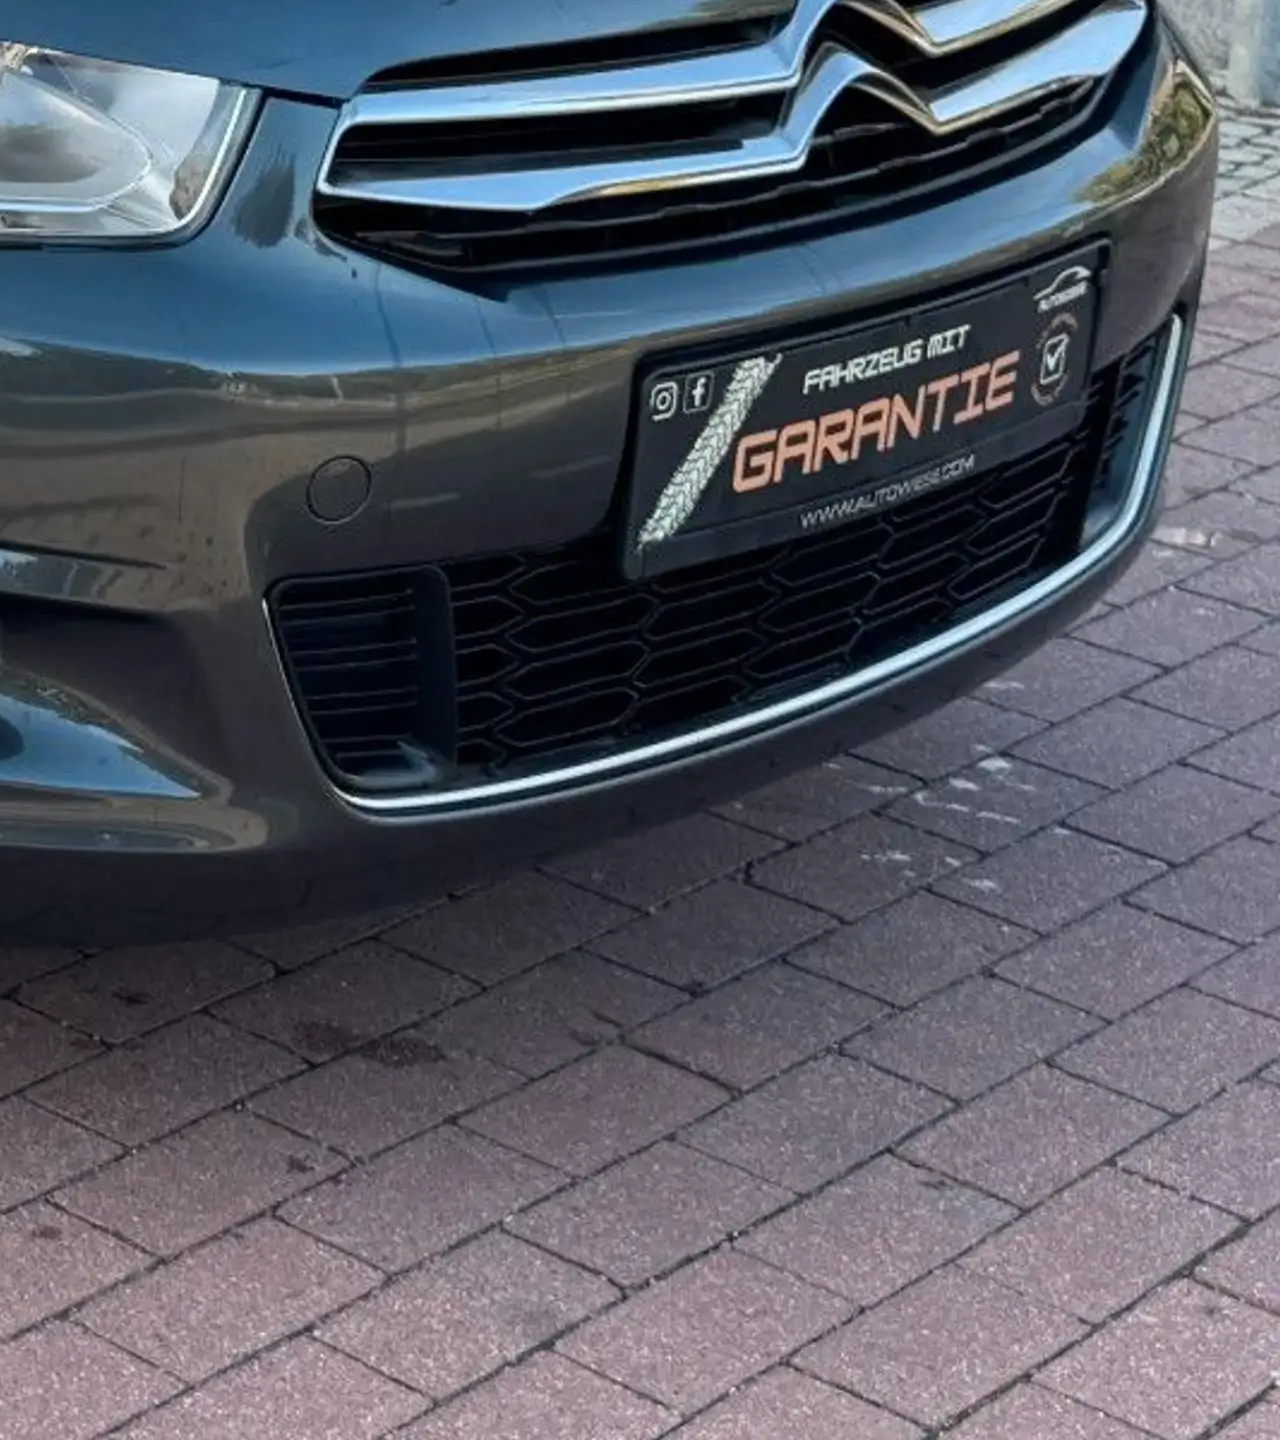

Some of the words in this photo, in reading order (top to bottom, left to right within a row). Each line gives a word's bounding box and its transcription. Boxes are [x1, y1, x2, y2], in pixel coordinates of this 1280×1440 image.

[802, 337, 923, 394] FAHRZEUG
[926, 324, 971, 360] MIT
[731, 350, 1020, 493] GARANTIE
